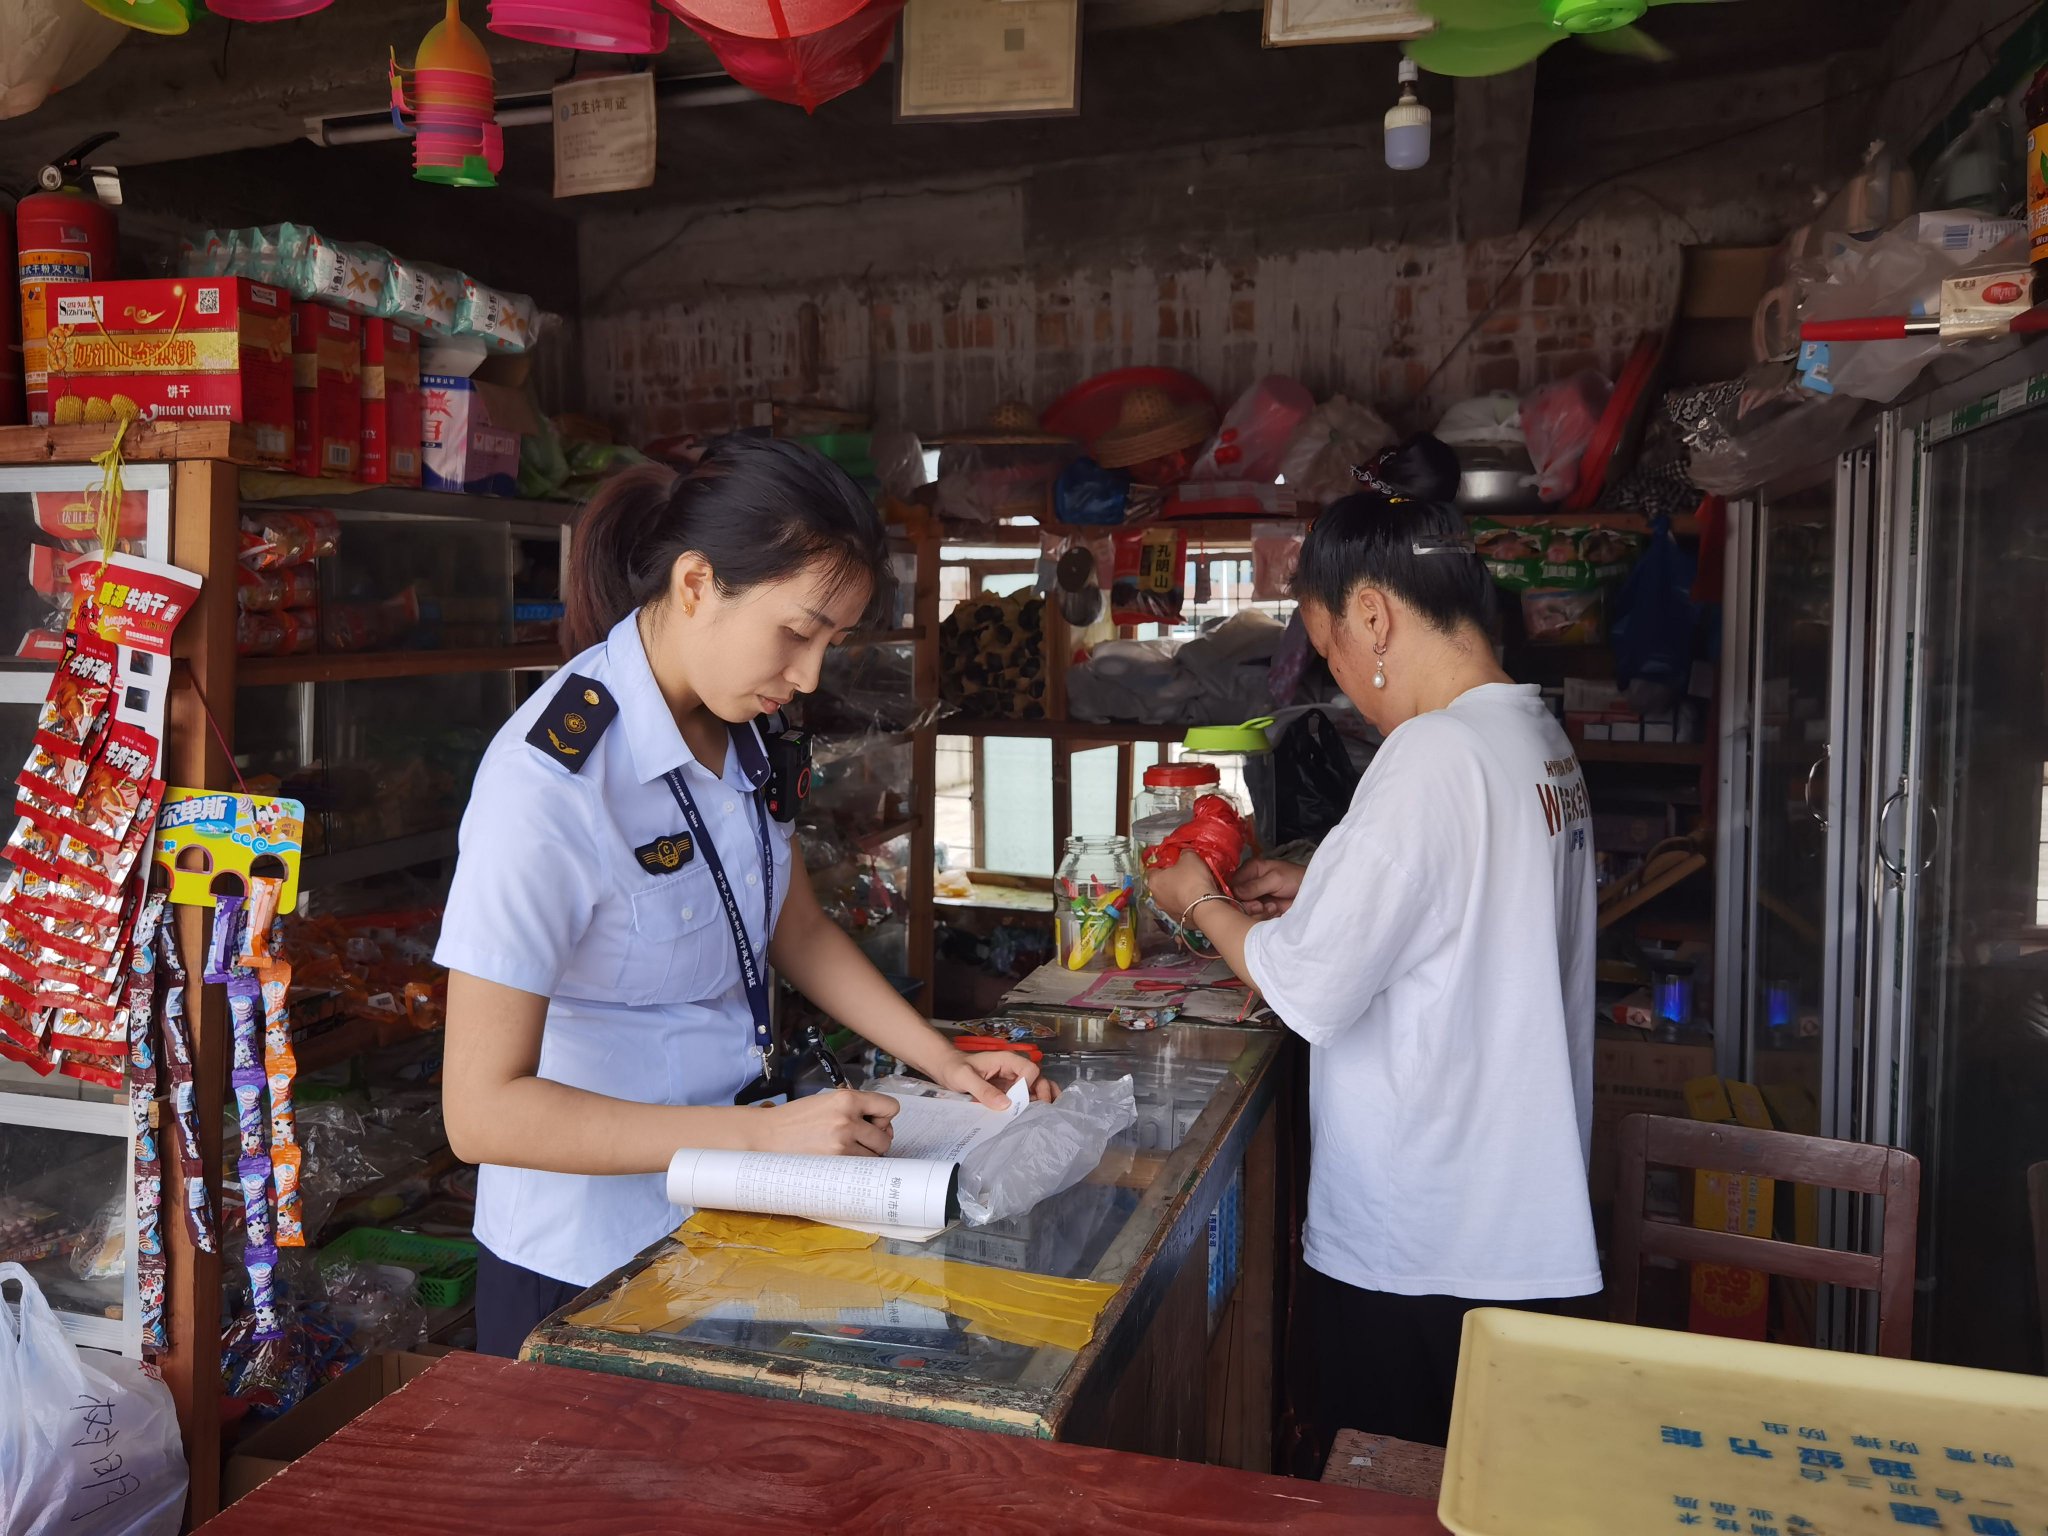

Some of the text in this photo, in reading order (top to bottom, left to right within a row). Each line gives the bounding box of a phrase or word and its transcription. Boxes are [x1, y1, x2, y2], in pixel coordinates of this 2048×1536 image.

[570, 96, 628, 117] 卫生许可证
[413, 272, 426, 312] 小鱼小虾
[484, 294, 498, 331] 小鱼小虾
[166, 384, 191, 399] 饼干
[158, 404, 232, 417] HIGH QUALITY
[1154, 544, 1171, 588] 孔明山
[160, 795, 229, 827] 尔卑斯
[668, 768, 700, 829] Enforcement China
[716, 869, 758, 989] 中华人民共和国行政执法证
[1761, 1421, 1828, 1442] 防虫
[1660, 1424, 1918, 1480] 超级节能
[1800, 1466, 2015, 1508] 一台顶三台
[1673, 1494, 1814, 1528] 专业品质
[1677, 1512, 1814, 1536] 端技术
